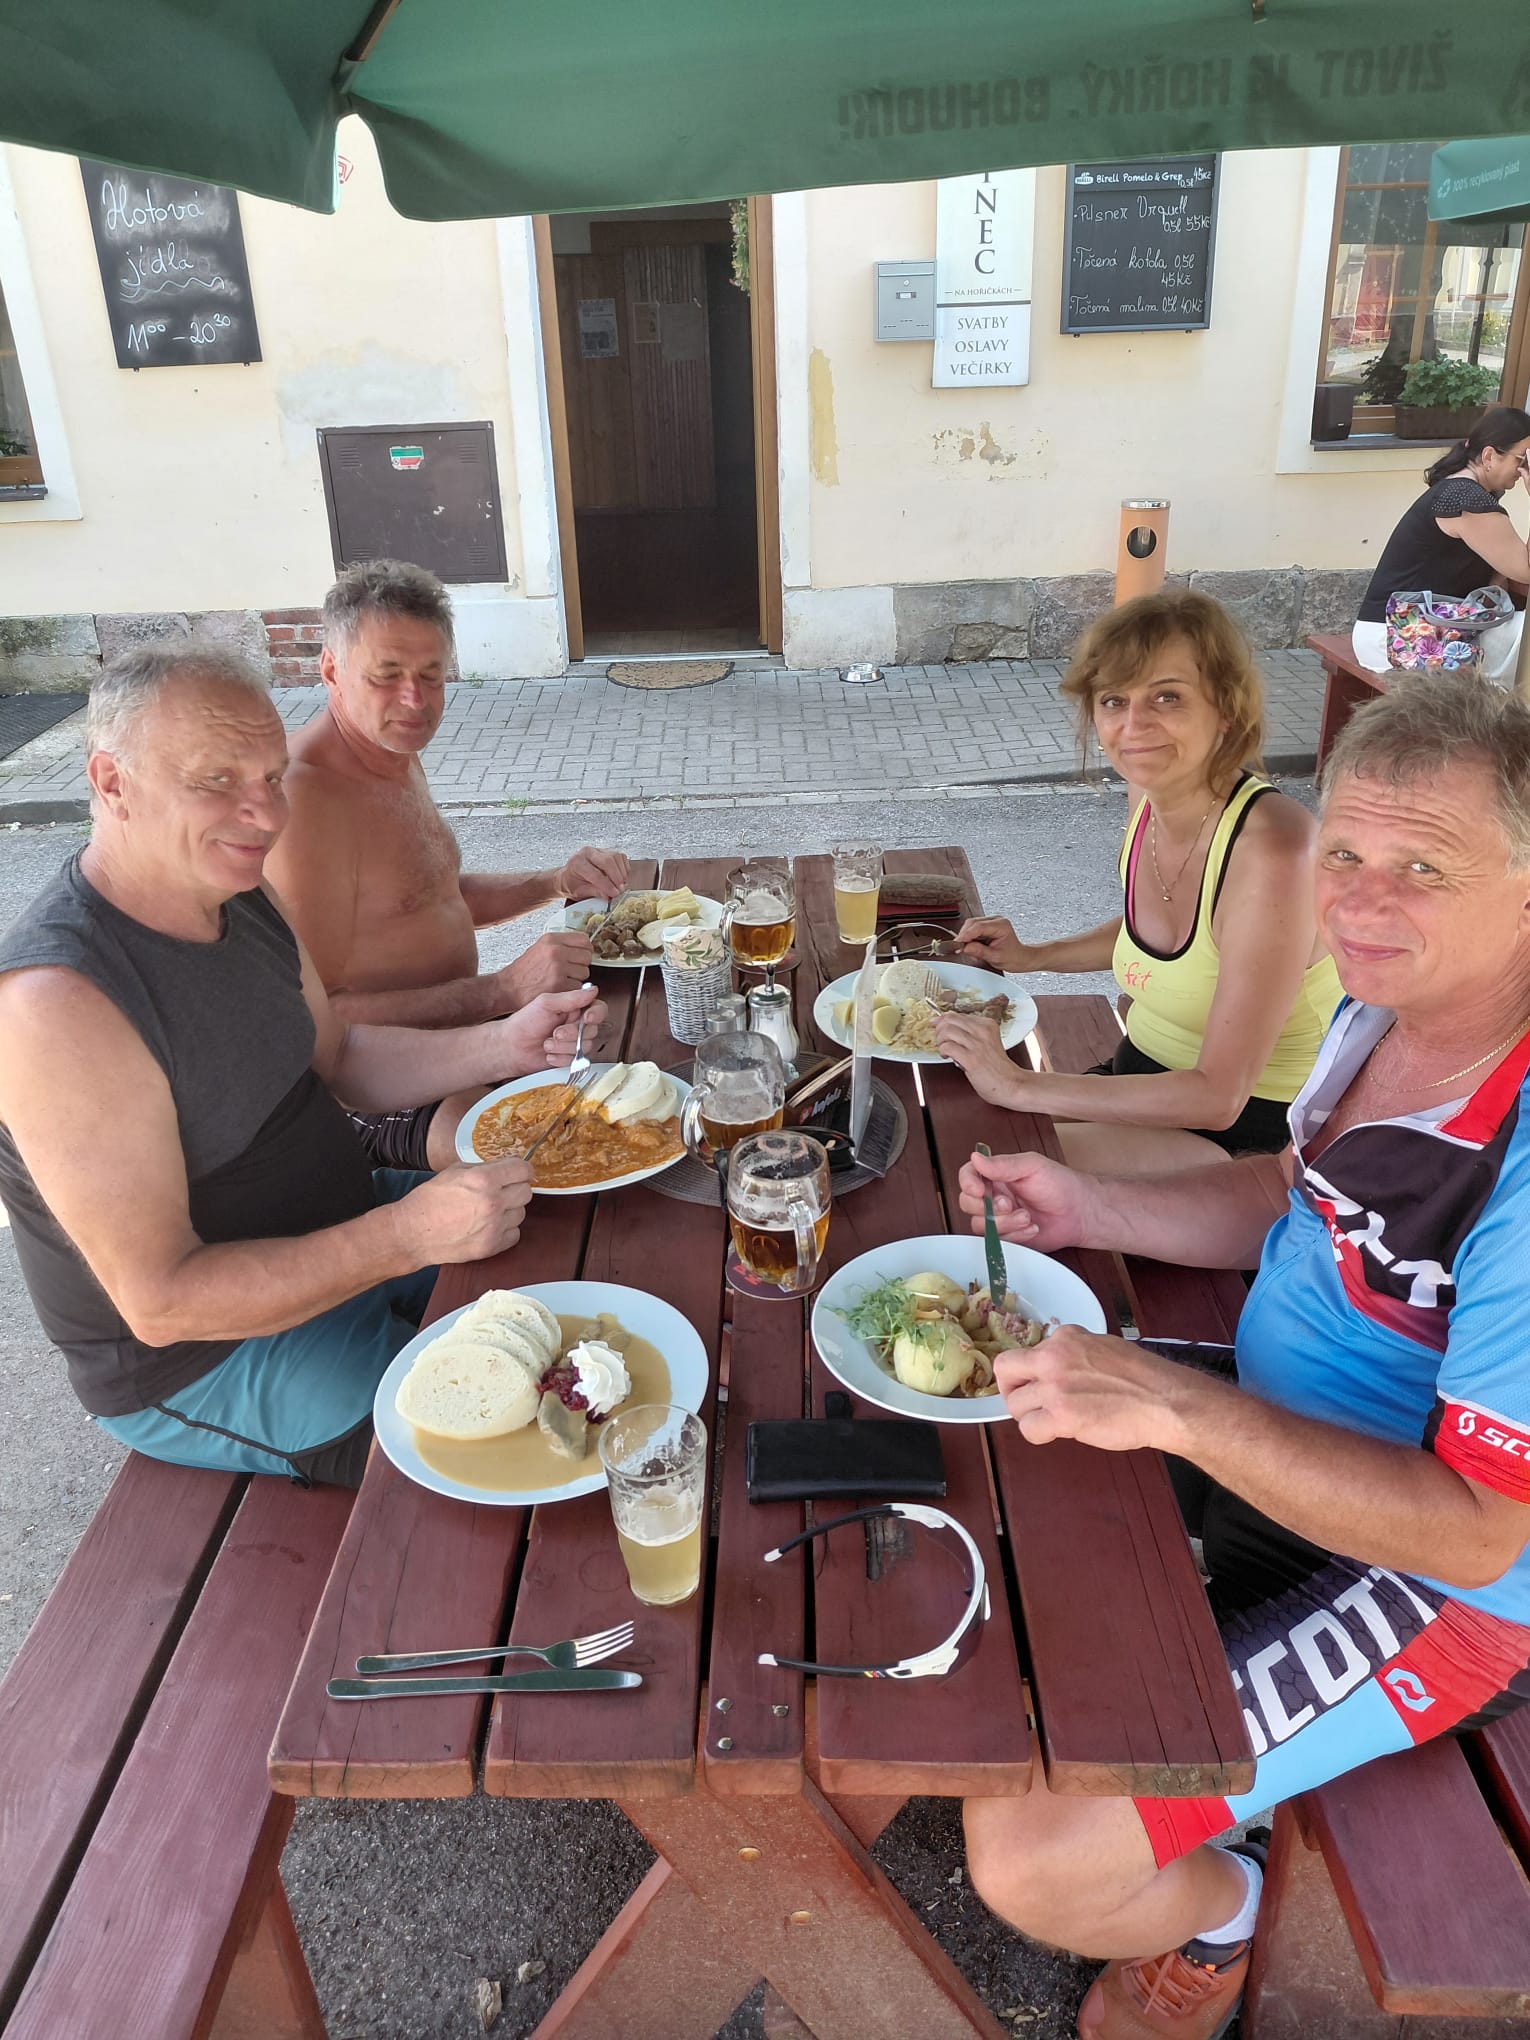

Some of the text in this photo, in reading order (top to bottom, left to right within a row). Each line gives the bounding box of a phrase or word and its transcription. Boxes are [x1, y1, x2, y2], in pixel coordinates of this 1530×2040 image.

[1096, 172, 1120, 183] Birell
[1123, 172, 1154, 183] Pomelo
[1161, 171, 1183, 187] Grep
[1504, 160, 1520, 177] plast
[102, 179, 205, 230] Hotová
[1077, 195, 1189, 225] Pilsner Urquell
[120, 242, 194, 287] jídla
[1075, 246, 1118, 269] Točená
[1070, 293, 1111, 315] Točená
[1119, 295, 1159, 313] malina
[957, 316, 1009, 331] SVATBY
[954, 339, 1009, 353] OSLAVY
[950, 359, 1013, 376] VEČÍRKY
[1477, 1426, 1530, 1462] SC
